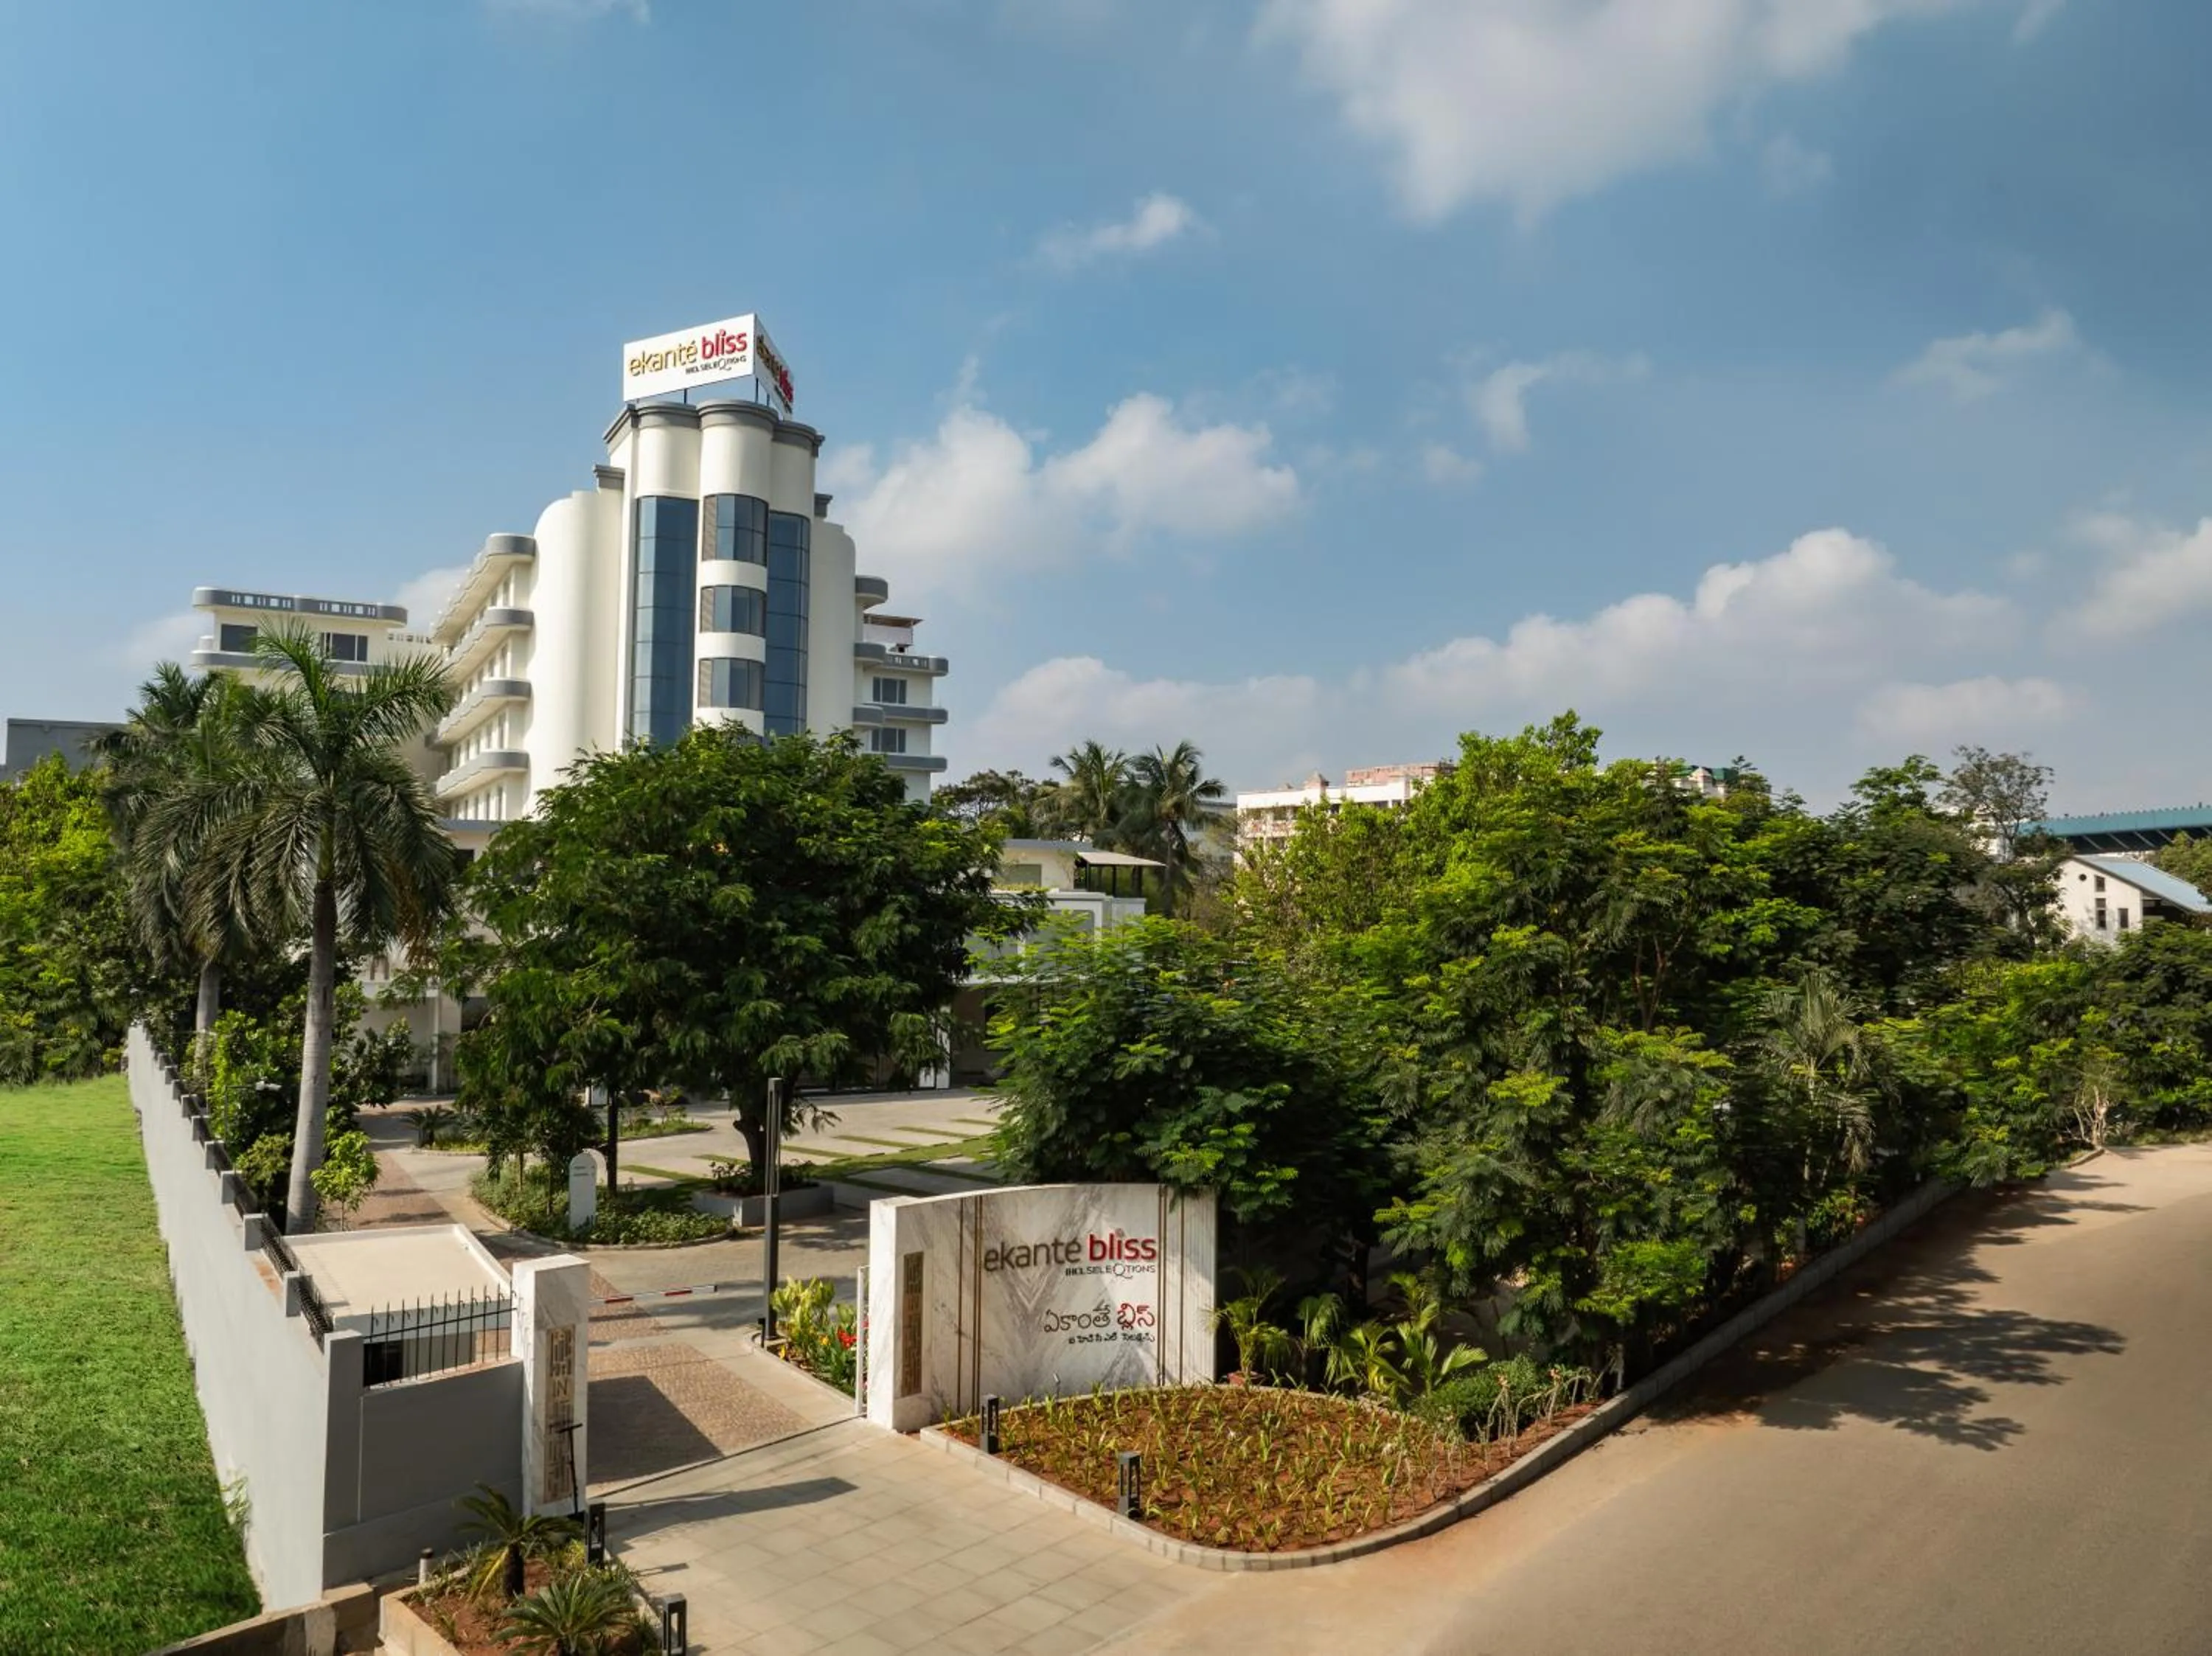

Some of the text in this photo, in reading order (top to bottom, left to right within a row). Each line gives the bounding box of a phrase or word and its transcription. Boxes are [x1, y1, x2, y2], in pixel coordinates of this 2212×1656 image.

[630, 340, 698, 377] ekanté
[702, 330, 748, 360] bliss
[984, 1228, 1157, 1272] ekanté bliss
[1087, 1263, 1156, 1279] SELEQTIONS
